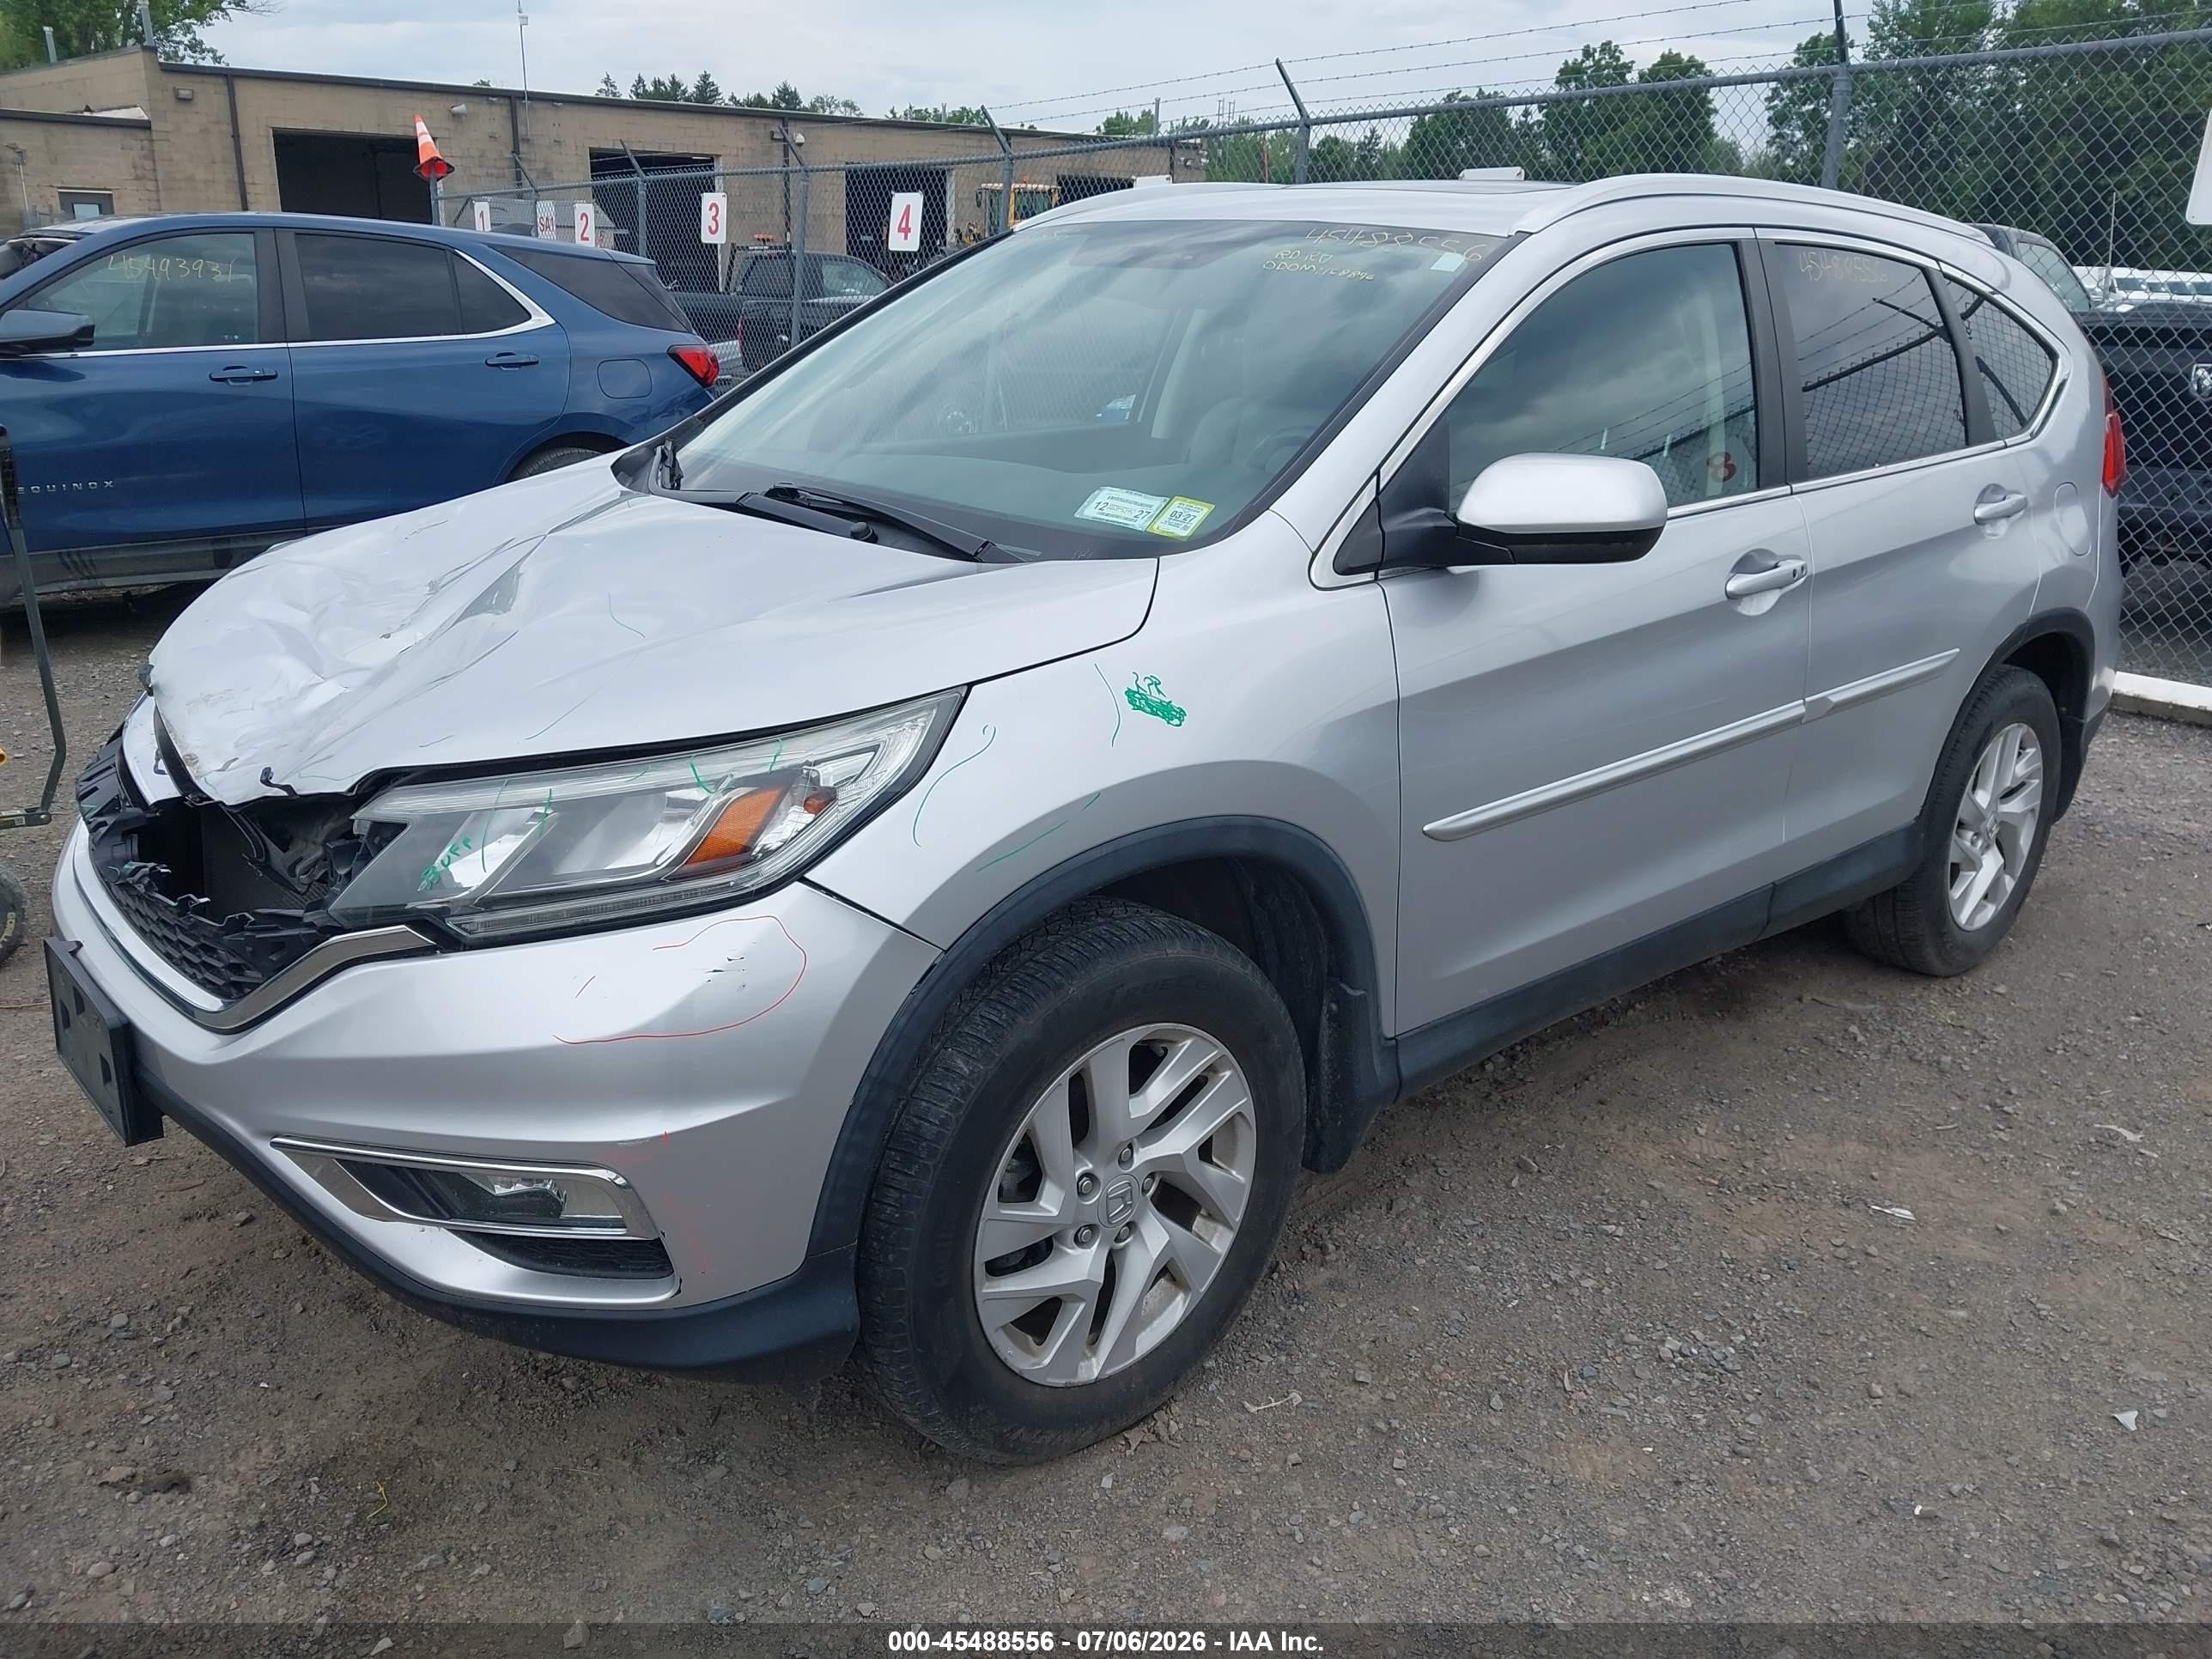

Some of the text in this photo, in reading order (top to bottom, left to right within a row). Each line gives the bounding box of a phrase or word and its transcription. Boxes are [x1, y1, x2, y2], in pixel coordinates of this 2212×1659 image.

[478, 210, 486, 232] 1
[538, 216, 556, 233] SA1
[580, 212, 590, 241] 2
[708, 202, 720, 235] 3
[896, 204, 912, 240] 4
[17, 480, 113, 495] EQUINOX
[1093, 501, 1109, 512] 12
